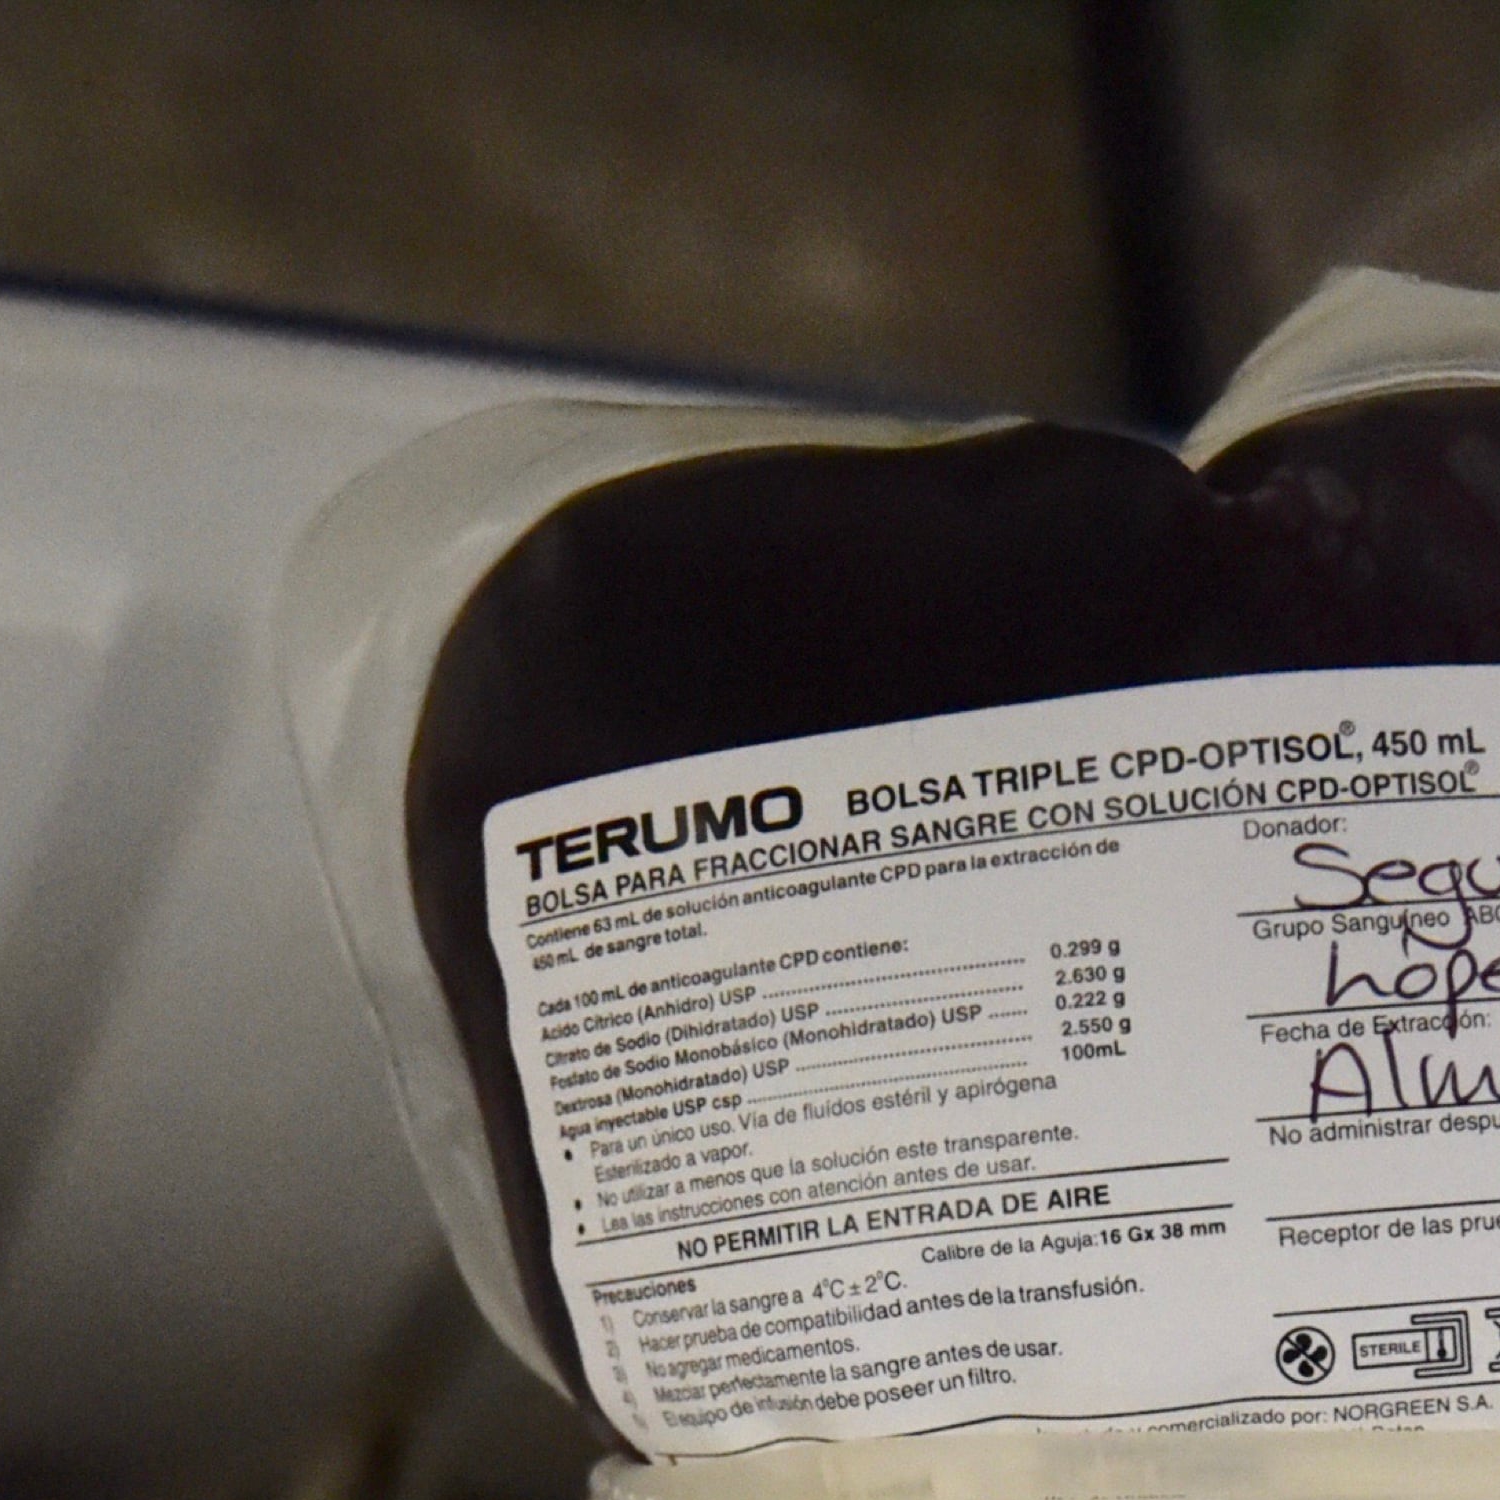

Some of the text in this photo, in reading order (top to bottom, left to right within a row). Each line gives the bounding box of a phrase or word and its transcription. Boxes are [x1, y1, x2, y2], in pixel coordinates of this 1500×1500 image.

[847, 774, 966, 816] BOLSA
[972, 755, 1099, 796] TRIPLE
[1372, 730, 1427, 758] 450
[1437, 727, 1486, 754] mL
[515, 785, 804, 882] TERUMO
[526, 879, 610, 918] BOLSA
[615, 864, 686, 897] PARA
[694, 830, 880, 882] FRACCIONAR
[890, 810, 1018, 849] SANGRE
[1027, 800, 1094, 832] CON
[1104, 778, 1266, 821] SOLUCIÓN
[1243, 814, 1347, 840] Donador:
[526, 838, 1120, 950] Contiene mL de solución anticoagulante CPD para extracción de
[606, 922, 707, 956] sangre total.
[1252, 918, 1324, 940] Grupo
[637, 938, 1102, 1025] (Anhidro) USP 0.299
[650, 939, 908, 992] anticoagulante CPD contiene:
[615, 966, 1107, 1052] Sodio (Dihidratado) USP 2.630
[624, 990, 1107, 1075] Sodio Monobásico (Monohidratado) USP 0.222
[1261, 1022, 1331, 1044] Fecha
[1337, 1018, 1365, 1038] de
[594, 1040, 1126, 1133] inyectable USP csp 100mL
[616, 1016, 1114, 1106] (Monohidratado) USP 2.550
[652, 1074, 1057, 1146] único de estéril apirógena
[1269, 1125, 1302, 1146] No
[1310, 1117, 1431, 1143] administrar
[594, 1142, 752, 1184] Esterilizado vapor.
[690, 1171, 746, 1192] menos
[751, 1164, 784, 1184] que
[812, 1143, 889, 1172] solución
[896, 1140, 938, 1159] este
[945, 1125, 1078, 1154] transparente.
[658, 1156, 1036, 1222] instrucciones con atención antes de usar.
[677, 1184, 1111, 1260] NO PERMITIR LA ENTRADA DE AIRE
[921, 1221, 1226, 1264] Calibre de 38 mm
[1279, 1224, 1380, 1247] Receptor
[1388, 1218, 1415, 1238] de
[1422, 1216, 1453, 1235] las
[592, 1276, 696, 1305] Precauciones
[633, 1291, 788, 1328] Conservar sangre
[639, 1275, 1144, 1352] Hacer prueba compatibilidad antes de transfusión.
[668, 1338, 860, 1380] agregar medicamentos.
[709, 1339, 1062, 1399] perfectamente sangre antes de usar.
[1359, 1340, 1420, 1357] STERILE
[816, 1368, 1016, 1410] debe poseer filtro.
[1292, 1396, 1493, 1426] por: NORGREEN S.A.
